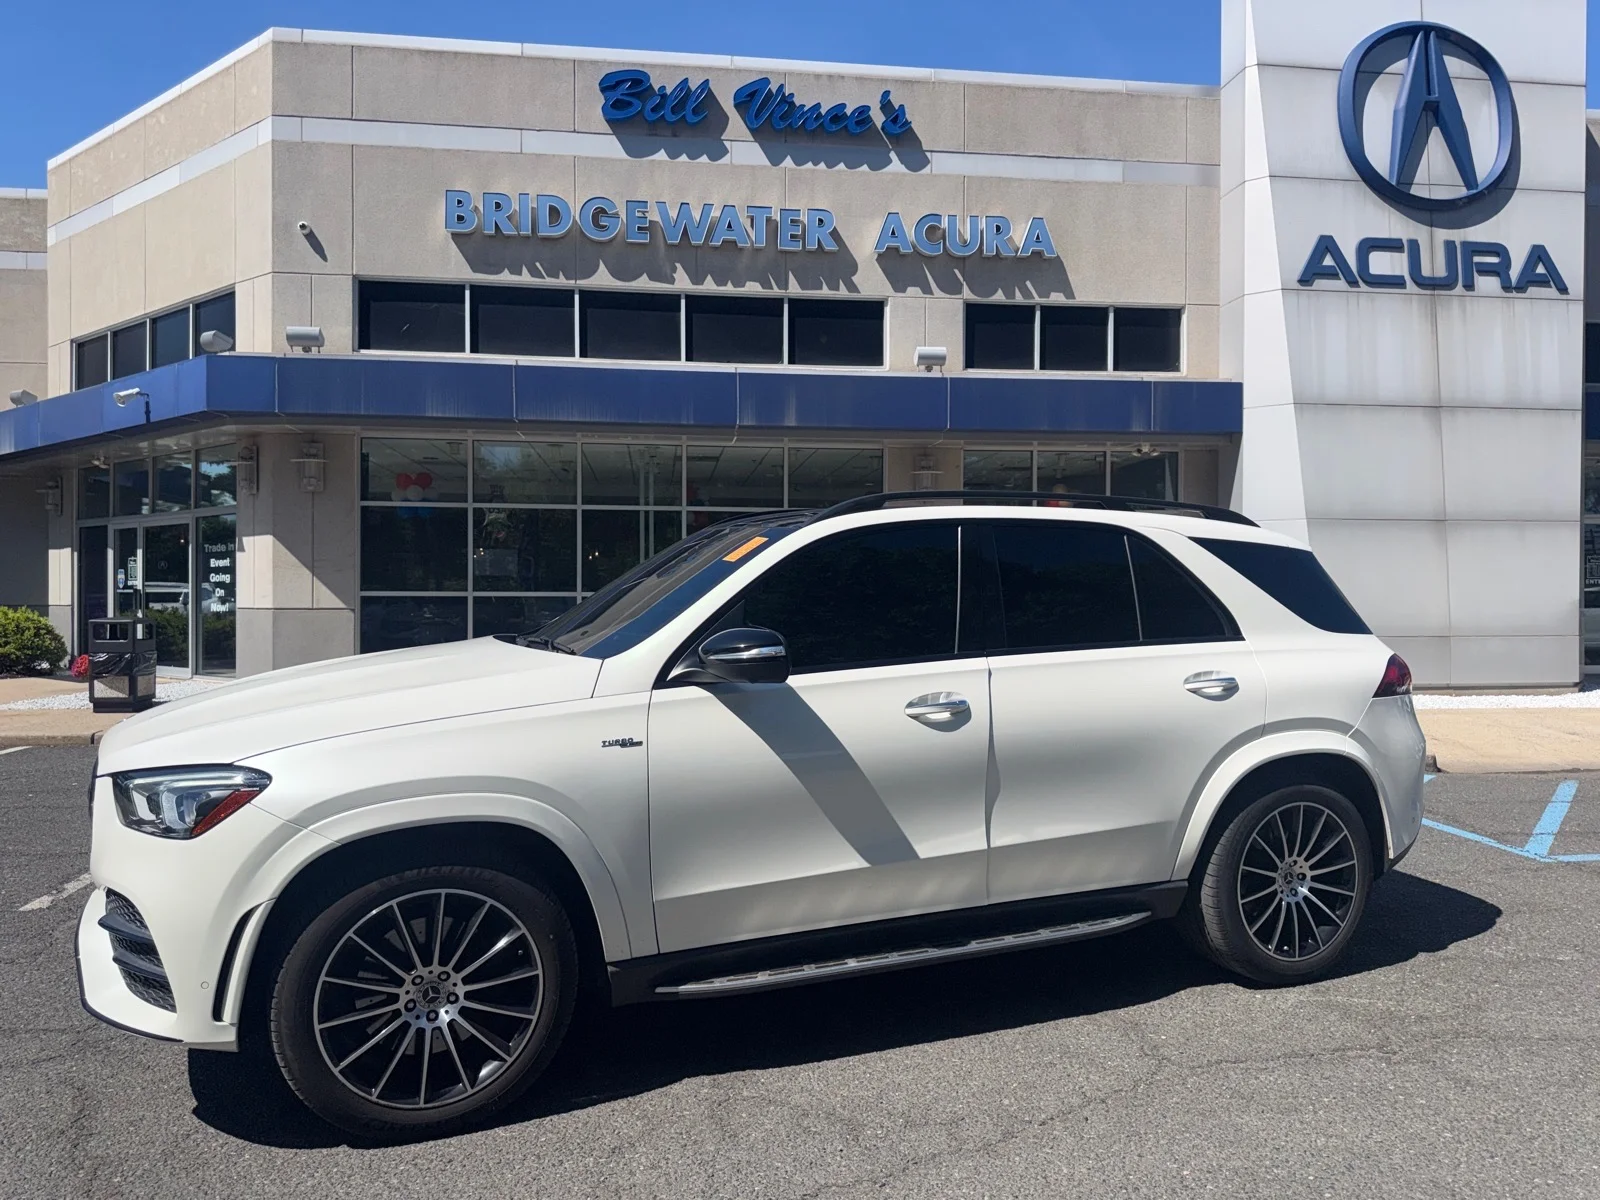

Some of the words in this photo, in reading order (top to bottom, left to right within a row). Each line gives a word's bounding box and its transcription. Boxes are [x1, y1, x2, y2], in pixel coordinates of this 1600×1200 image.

[599, 69, 710, 124] Bill
[733, 77, 912, 134] Vince's
[445, 189, 840, 253] BRIDGEWATER
[874, 212, 1057, 259] ACURA
[1297, 234, 1569, 295] ACURA
[204, 543, 227, 553] Trade
[210, 557, 230, 568] Event
[210, 573, 231, 583] Going
[215, 588, 225, 597] On
[211, 603, 229, 613] Now!
